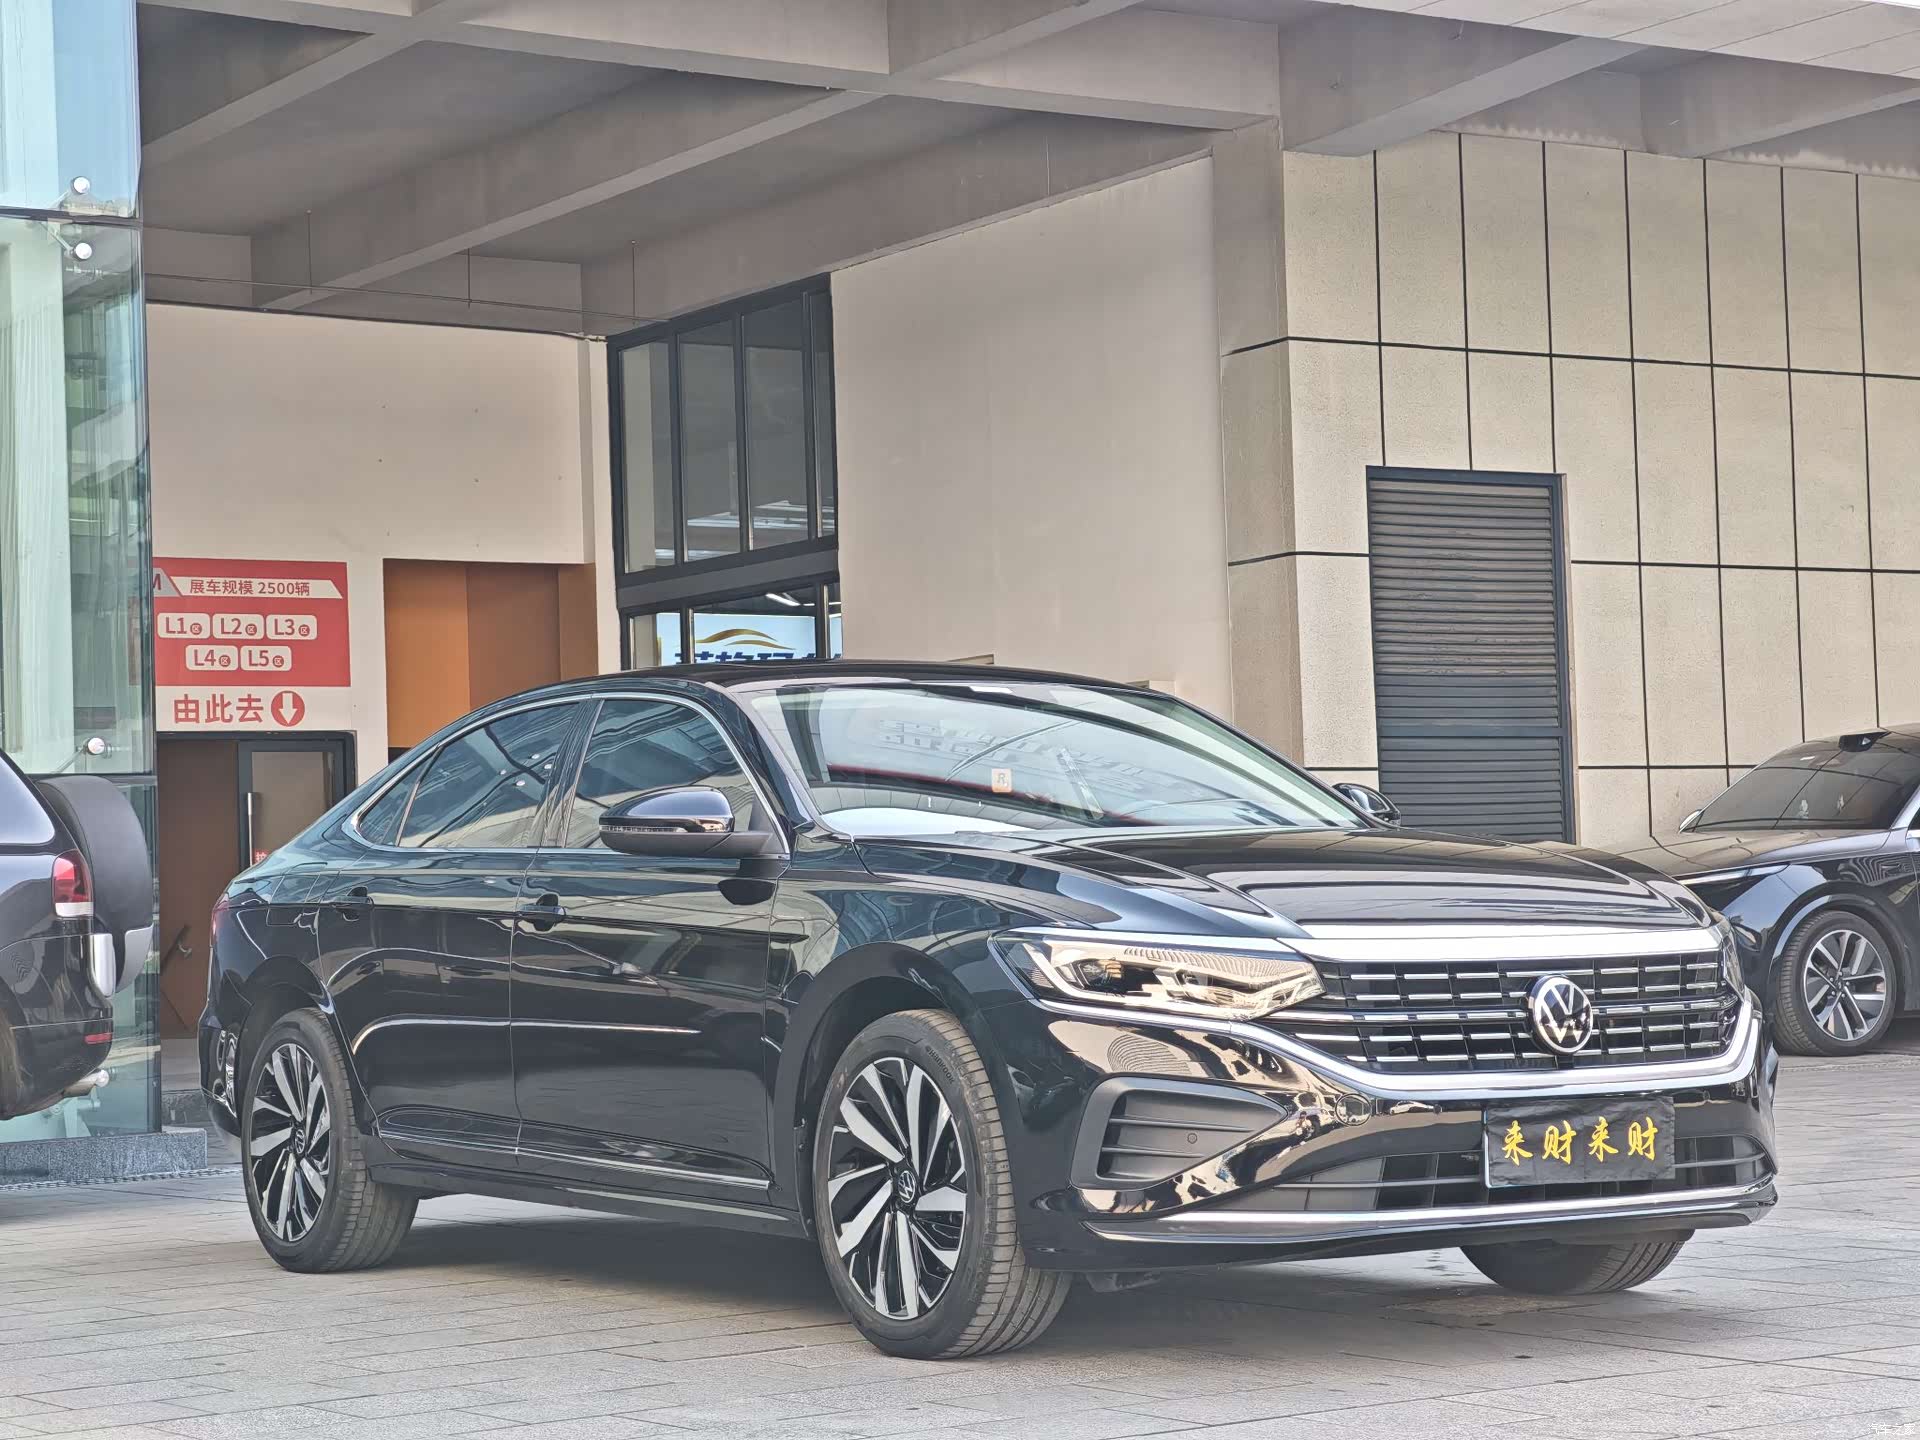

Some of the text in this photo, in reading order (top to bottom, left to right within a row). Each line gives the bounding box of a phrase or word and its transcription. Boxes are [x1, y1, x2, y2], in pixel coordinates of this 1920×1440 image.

[190, 579, 310, 596] 展车规模 2500辆
[173, 693, 264, 724] 由此去
[1502, 1116, 1658, 1166] 来财来财
